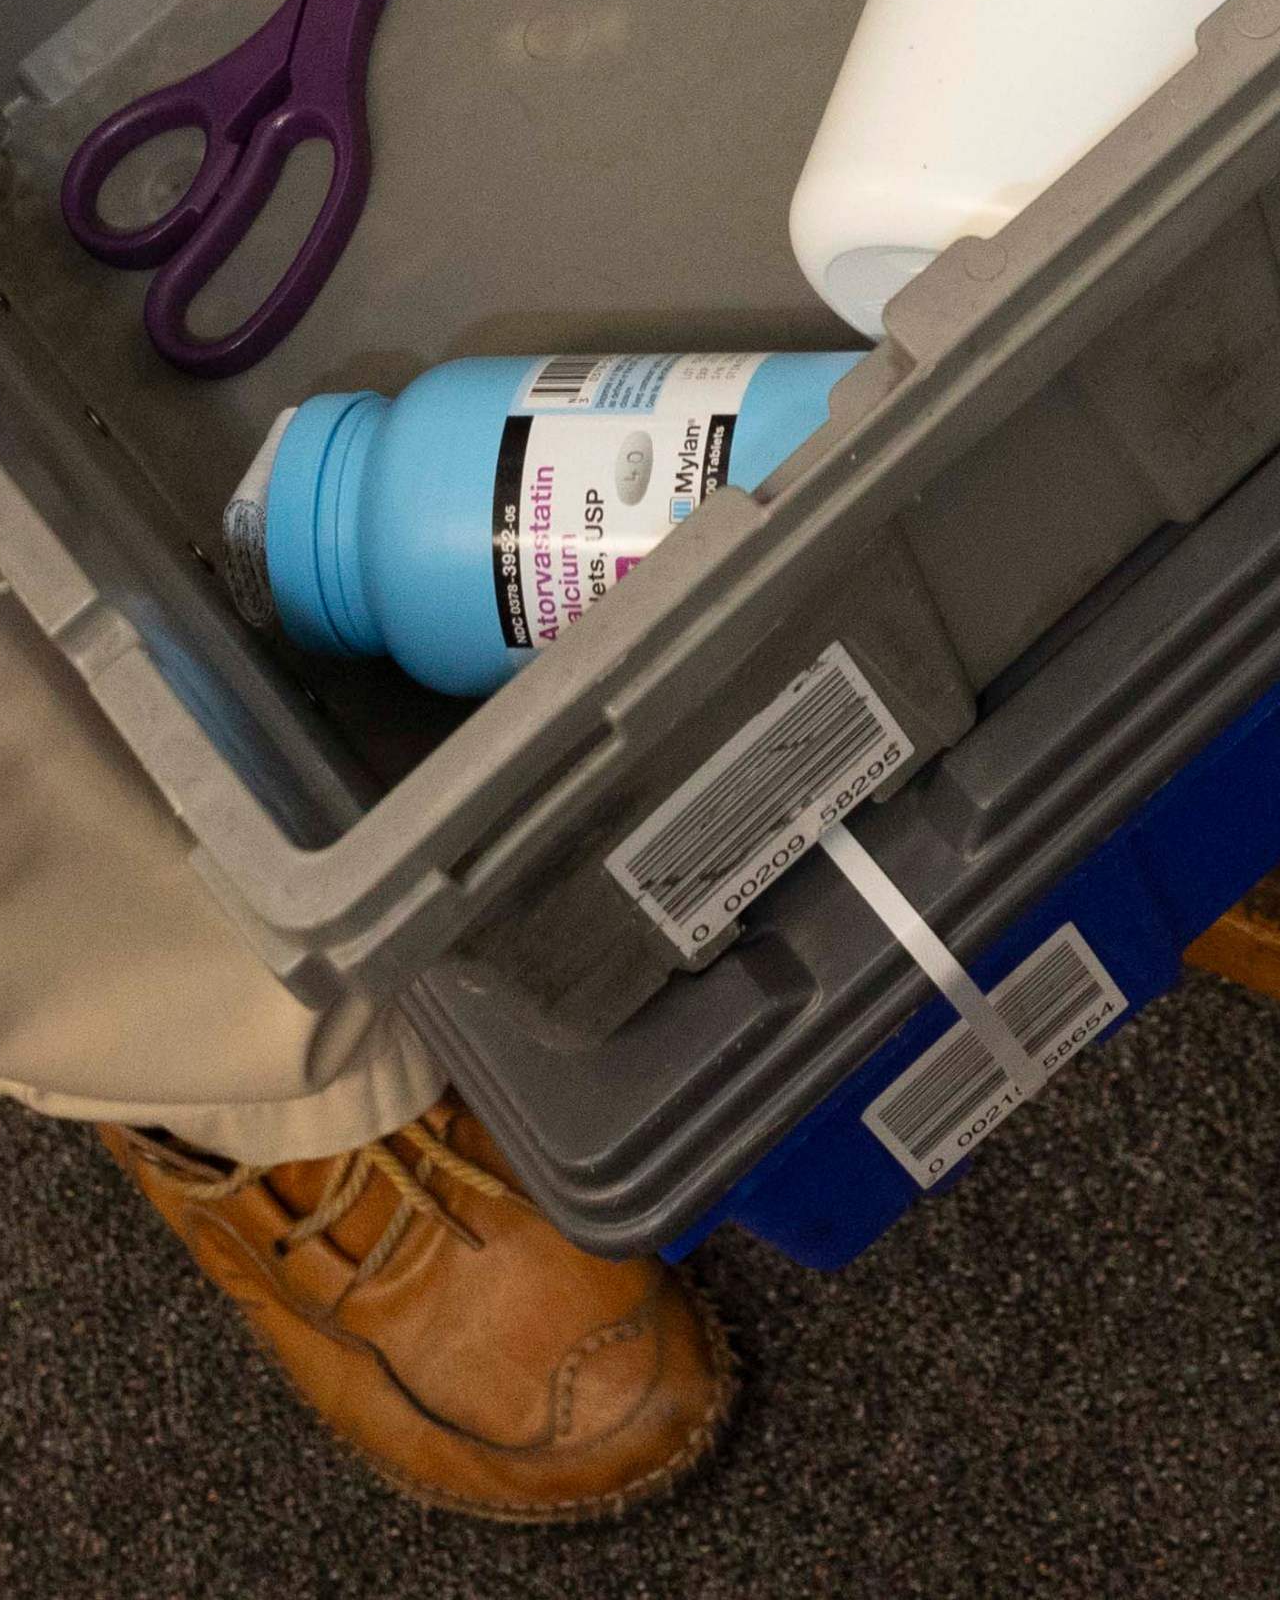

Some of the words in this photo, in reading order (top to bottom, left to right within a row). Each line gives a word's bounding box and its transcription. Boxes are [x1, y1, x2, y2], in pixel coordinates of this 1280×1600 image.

[673, 423, 704, 494] Mylan
[707, 424, 725, 475] Tablets
[512, 464, 581, 640] Atorvastatin
[581, 487, 608, 540] USP
[491, 504, 534, 613] 0378-3952-05
[550, 533, 593, 622] alcium
[511, 615, 531, 644] NDC
[690, 923, 711, 943] 0
[722, 833, 807, 913] 00209
[818, 745, 902, 824] 58295
[927, 1156, 946, 1174] 0
[954, 1086, 1025, 1147] 0021
[1039, 1000, 1118, 1069] 58654
